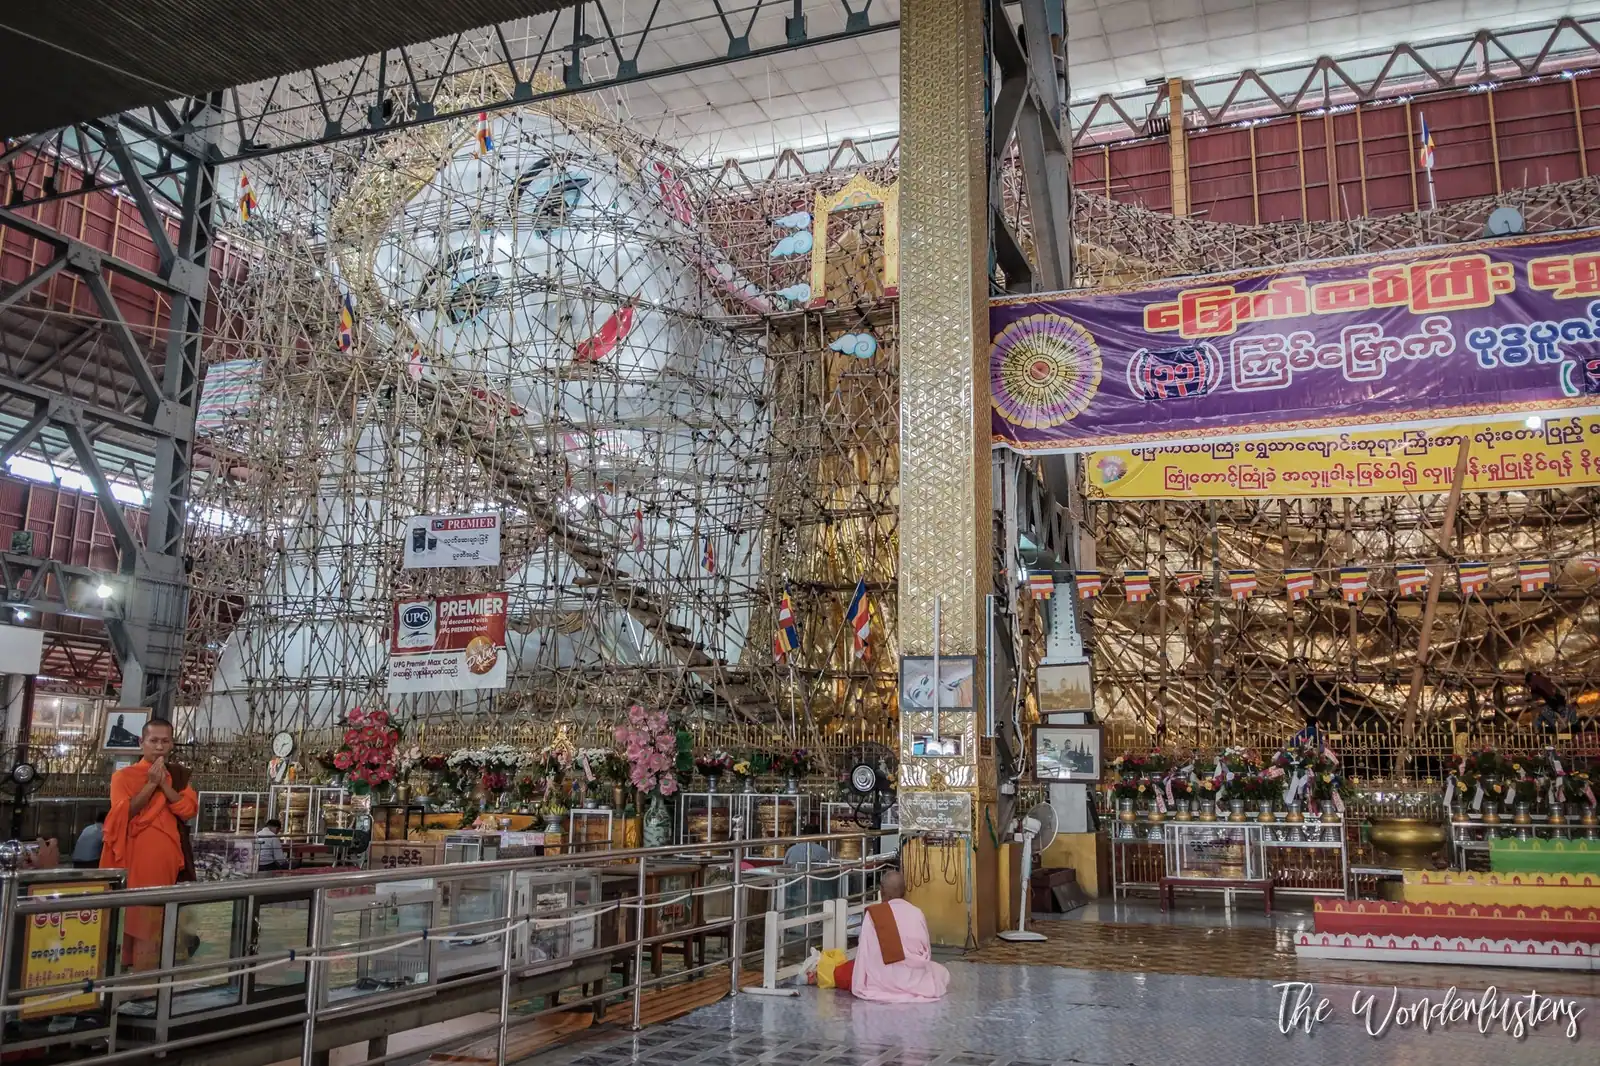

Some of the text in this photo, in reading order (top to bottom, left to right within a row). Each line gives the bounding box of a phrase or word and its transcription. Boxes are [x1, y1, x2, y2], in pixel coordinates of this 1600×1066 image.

[448, 517, 495, 530] PREMIER
[440, 597, 504, 617] PREMIER
[405, 611, 429, 624] UPG
[393, 660, 406, 668] UPG
[427, 658, 441, 666] Max
